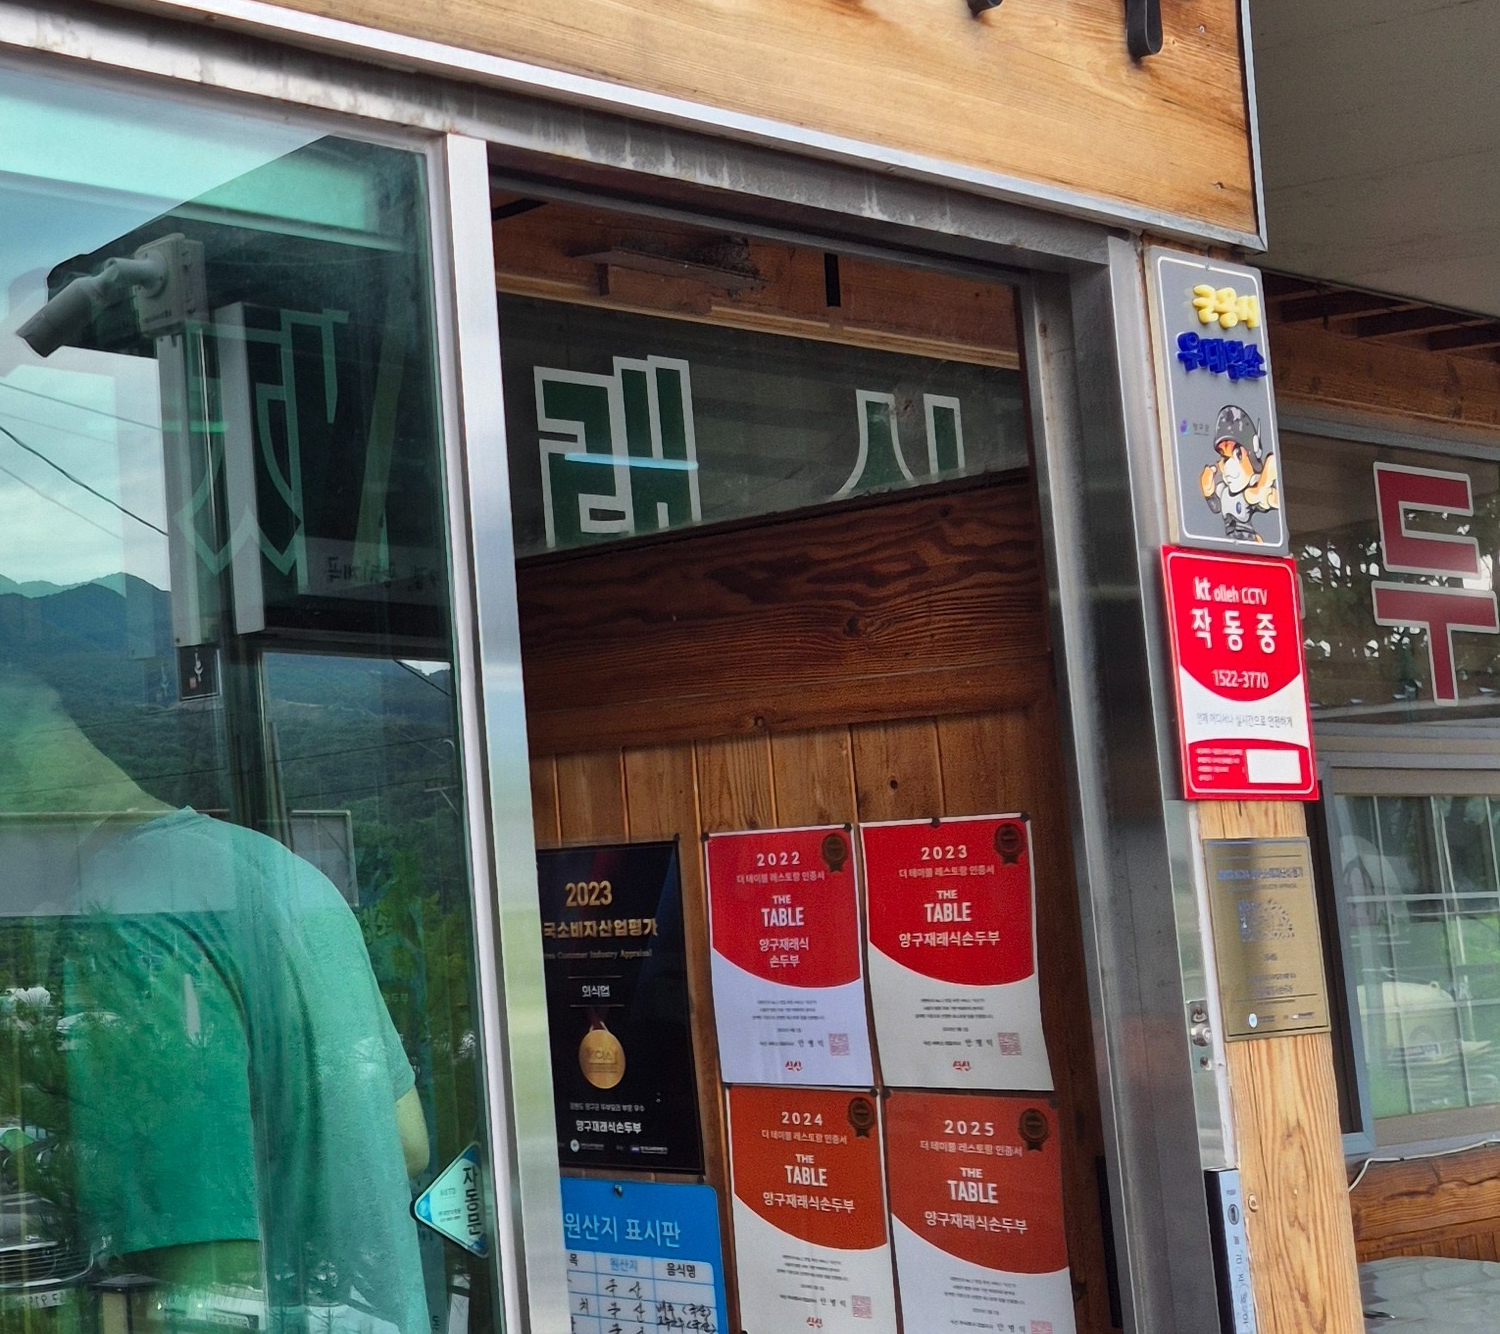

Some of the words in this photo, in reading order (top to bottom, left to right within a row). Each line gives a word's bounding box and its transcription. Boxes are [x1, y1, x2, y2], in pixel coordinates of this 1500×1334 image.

[1194, 576, 1211, 601] kt
[1213, 584, 1239, 603] olleh
[1241, 588, 1268, 606] CCTV
[1212, 669, 1269, 689] 1522-3770
[757, 851, 800, 867] 2022
[921, 845, 968, 860] 2023
[564, 880, 613, 907] 2023
[772, 894, 791, 905] THE
[936, 889, 959, 900] THE
[761, 907, 804, 927] TABLE
[924, 902, 973, 923] TABLE
[543, 917, 659, 940] 국소비자산업평가
[759, 937, 809, 952] 양구재래식
[898, 931, 1001, 948] 양구재래식손두부
[769, 954, 800, 968] 손두부
[781, 1111, 823, 1127] 2024
[944, 1120, 995, 1136] 2025
[795, 1153, 815, 1164] THE
[784, 1165, 828, 1187] TABLE
[960, 1167, 983, 1179] THE
[947, 1179, 999, 1204] TABLE
[462, 1167, 482, 1236] 자동문
[763, 1191, 856, 1214] 양구재래식손두부
[564, 1212, 619, 1243] 원산지
[624, 1217, 681, 1248] 표시판
[924, 1210, 1029, 1235] 양구재래식손두부
[666, 1262, 696, 1279] 음식명
